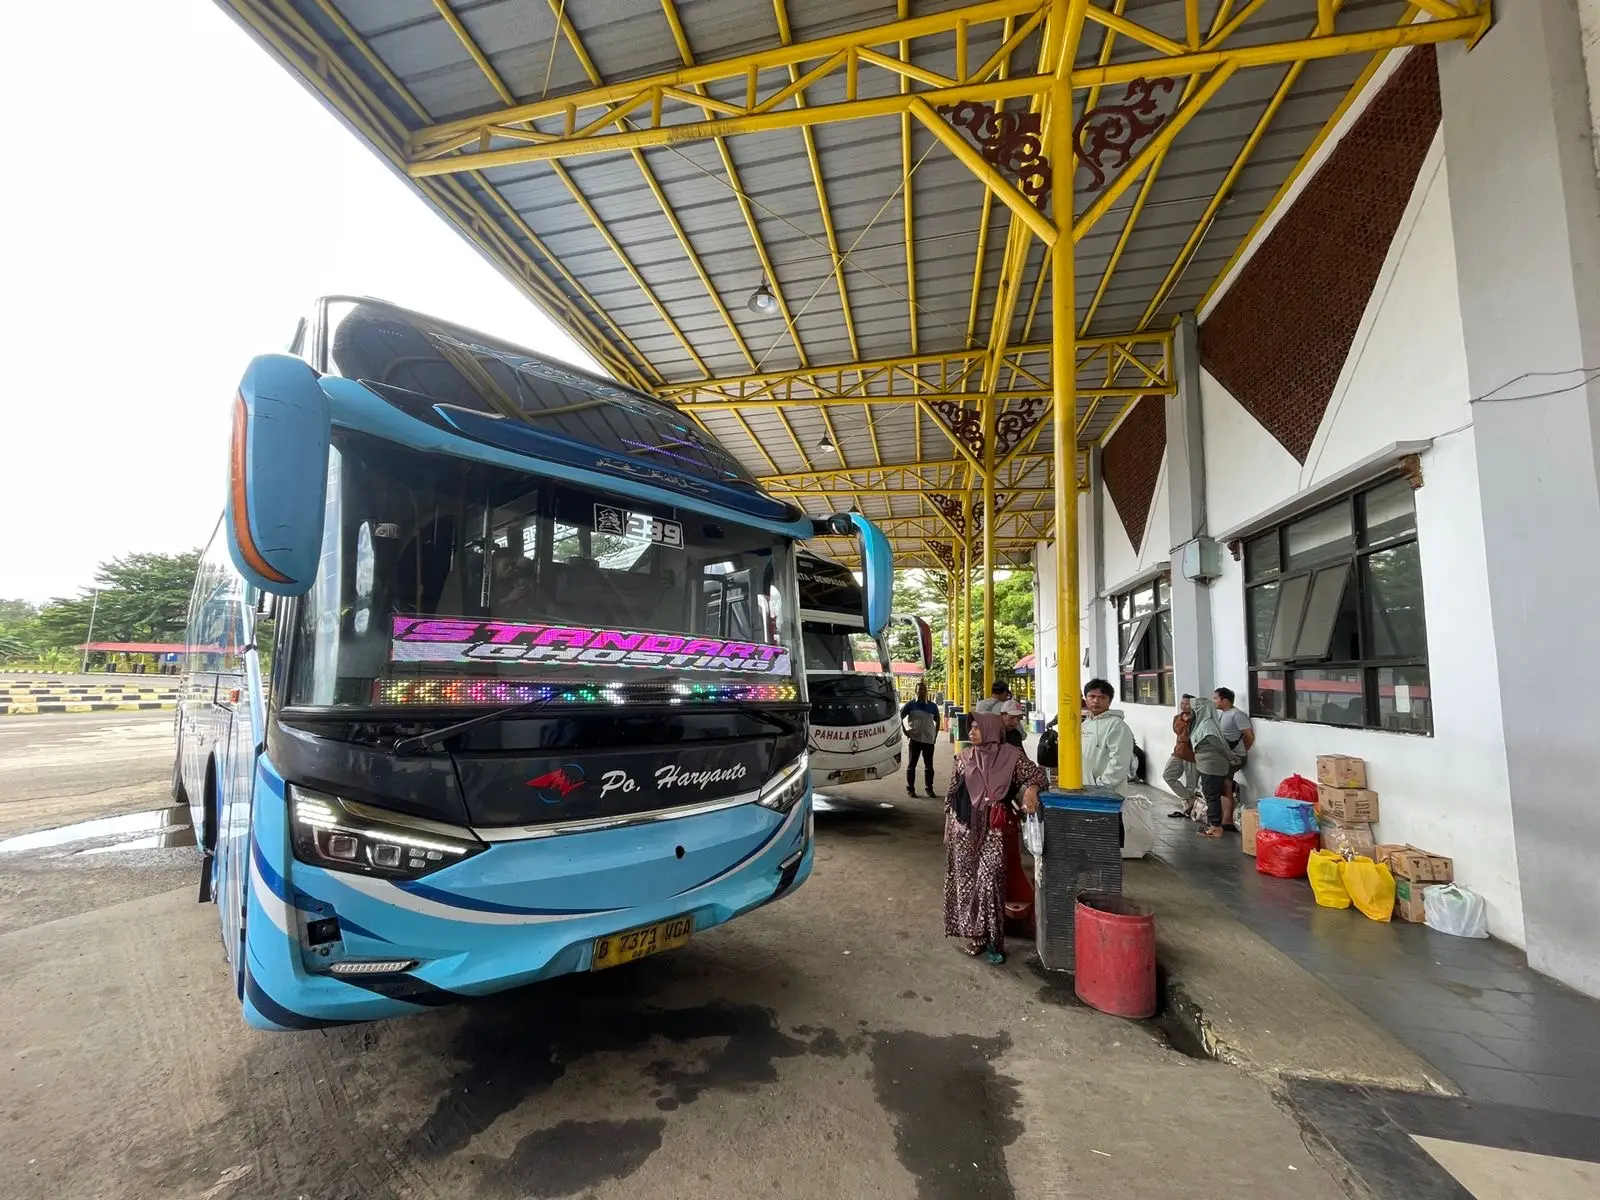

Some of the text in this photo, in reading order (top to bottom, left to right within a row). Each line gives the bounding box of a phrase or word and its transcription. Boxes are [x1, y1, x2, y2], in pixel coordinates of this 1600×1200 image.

[626, 516, 680, 544] 239
[402, 620, 785, 660] STANDART
[467, 642, 771, 671] GHOSTING
[814, 726, 886, 740] PAHALA KENCANA
[600, 761, 748, 799] Po. Haryanto
[619, 926, 658, 953] 7371
[664, 919, 691, 940] VGA
